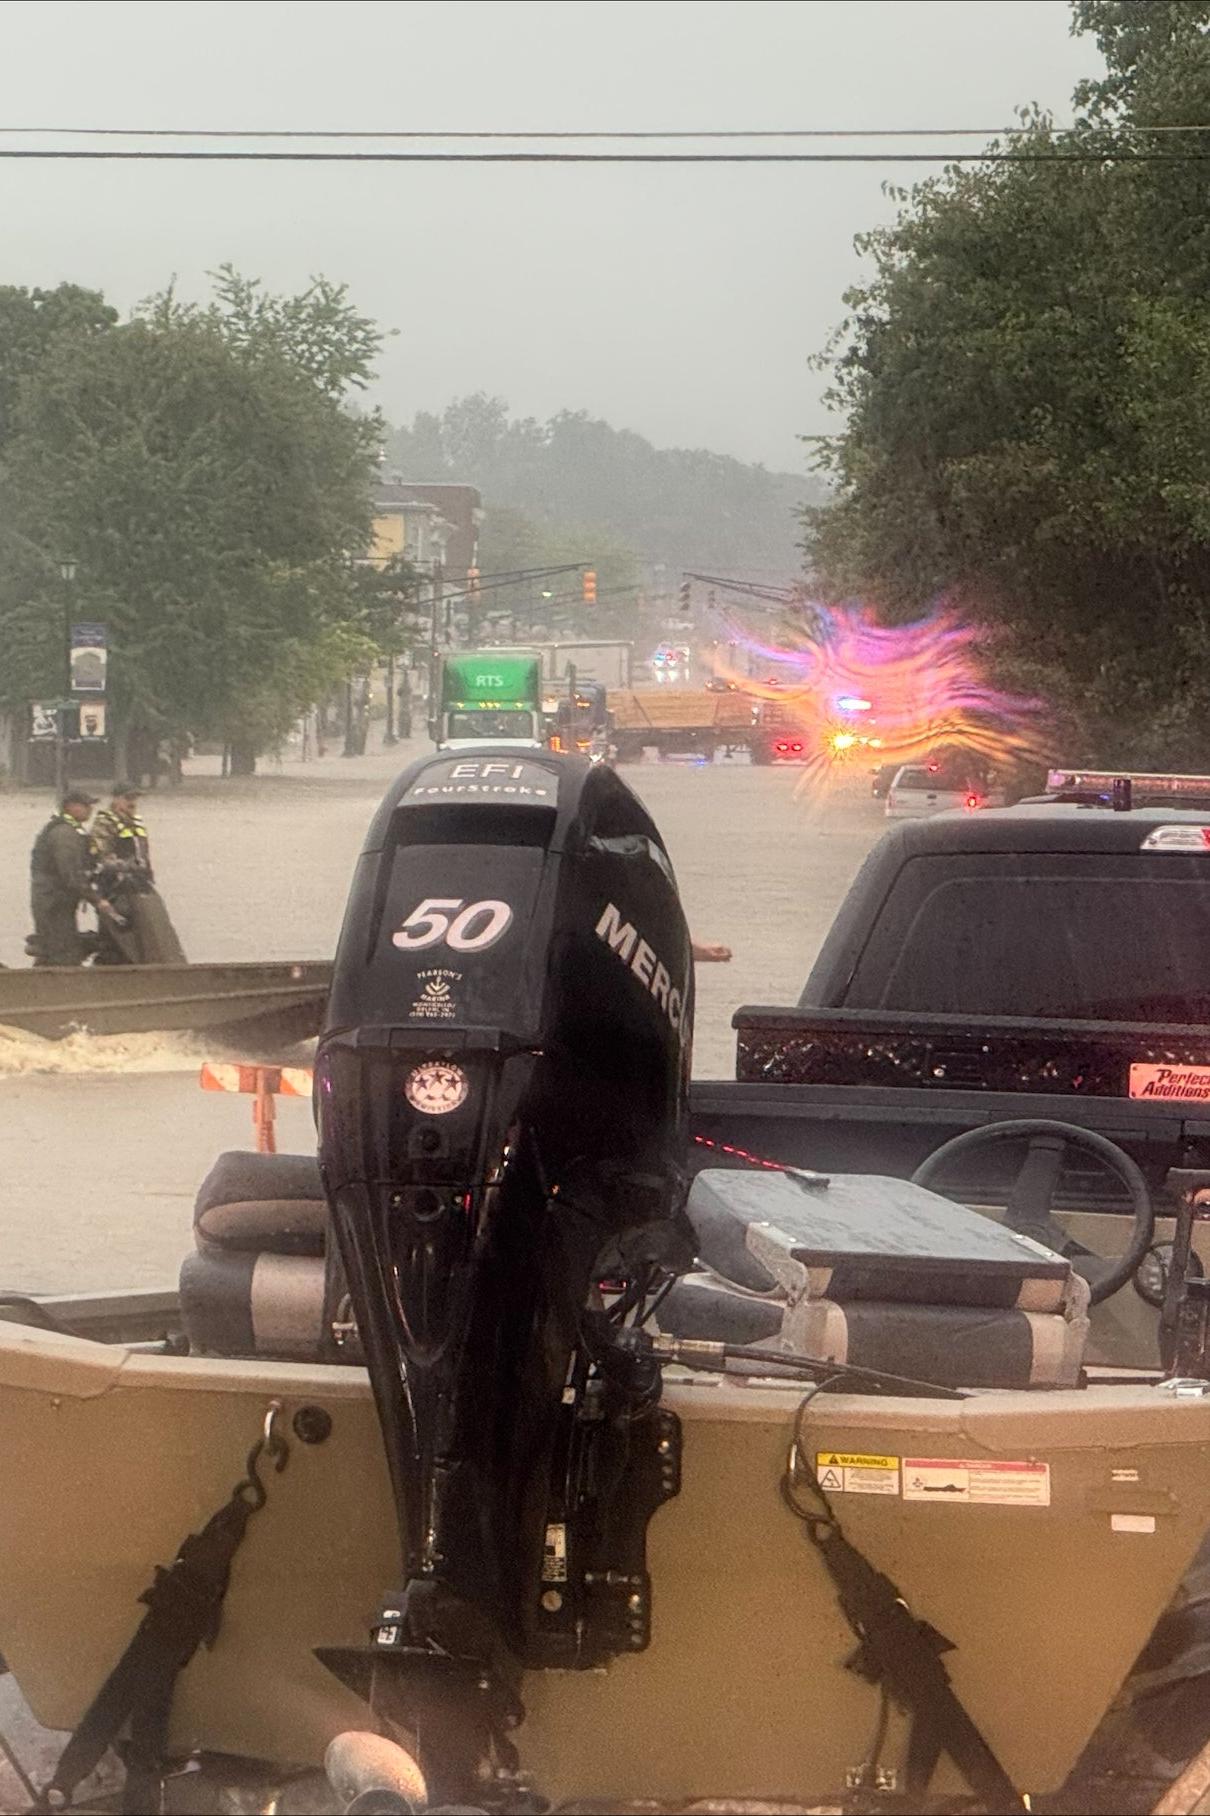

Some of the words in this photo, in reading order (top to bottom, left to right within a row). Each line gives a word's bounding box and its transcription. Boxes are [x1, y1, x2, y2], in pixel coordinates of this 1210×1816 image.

[476, 675, 504, 687] RTS
[449, 764, 524, 779] EFI
[413, 784, 547, 797] FourStroke
[392, 898, 512, 953] 50
[594, 901, 682, 1030] MERC
[1154, 1068, 1210, 1086] Perfec
[1140, 1081, 1210, 1099] Additions
[840, 1456, 888, 1467] WARNING
